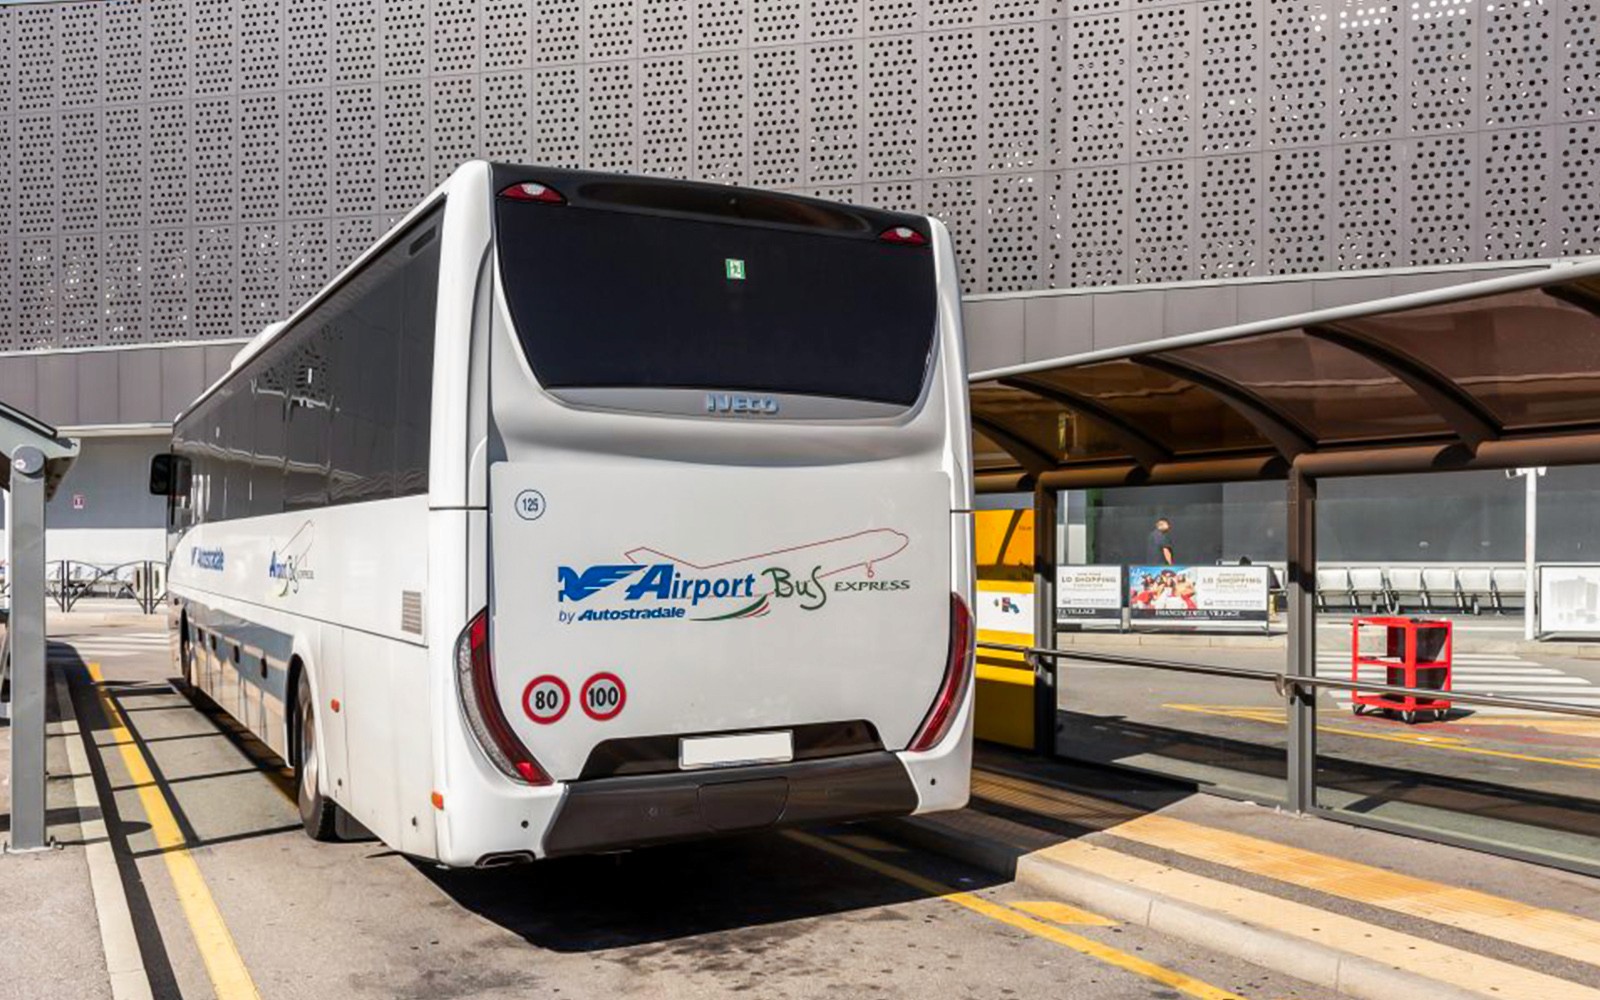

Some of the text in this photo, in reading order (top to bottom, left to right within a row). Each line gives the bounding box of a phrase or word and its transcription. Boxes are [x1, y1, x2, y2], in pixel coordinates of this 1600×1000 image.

[705, 393, 779, 414] IVECO
[522, 497, 539, 512] 125
[624, 564, 911, 611] Airport Bus EXPRESS
[558, 606, 686, 625] by Autostradale
[535, 689, 559, 711] 80
[588, 685, 619, 708] 100
